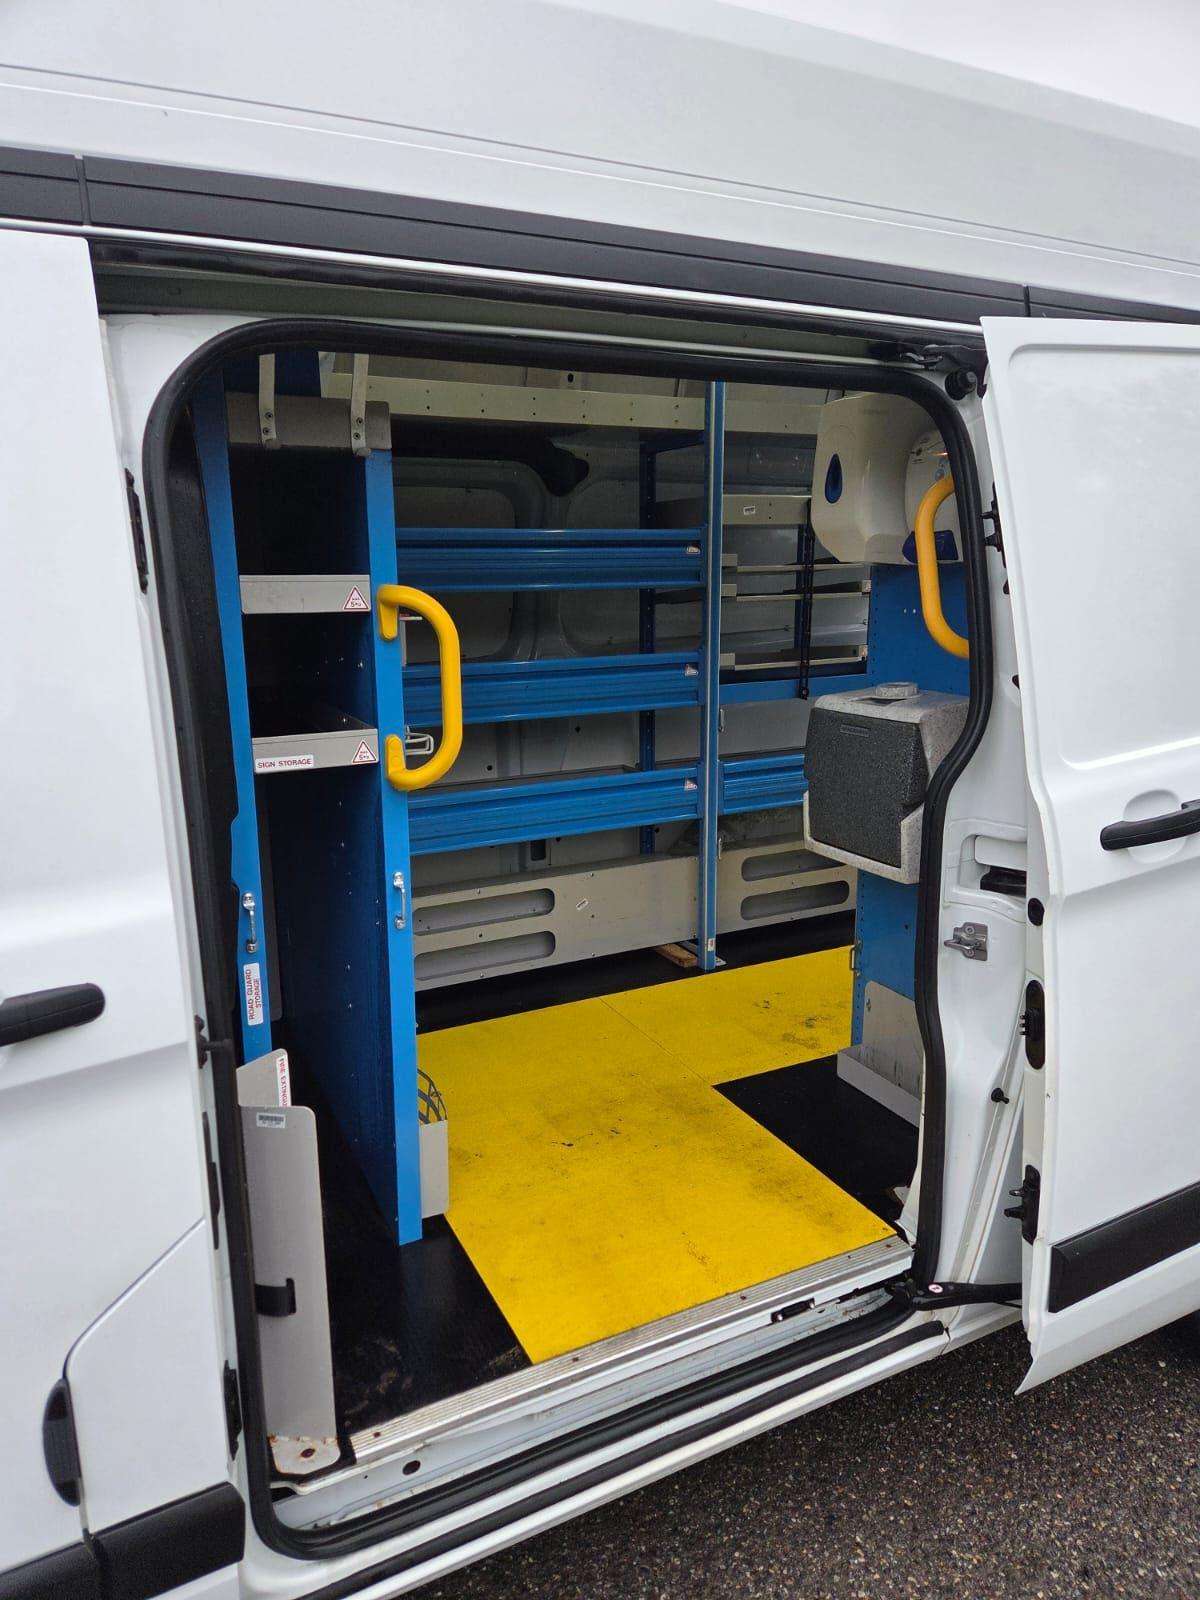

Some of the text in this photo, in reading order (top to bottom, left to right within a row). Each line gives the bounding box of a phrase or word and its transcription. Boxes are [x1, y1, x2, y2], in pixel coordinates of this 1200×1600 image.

[257, 758, 313, 769] SIGN STORAGE
[245, 969, 255, 1021] ROAD GUARD
[253, 978, 262, 1009] STORAGE
